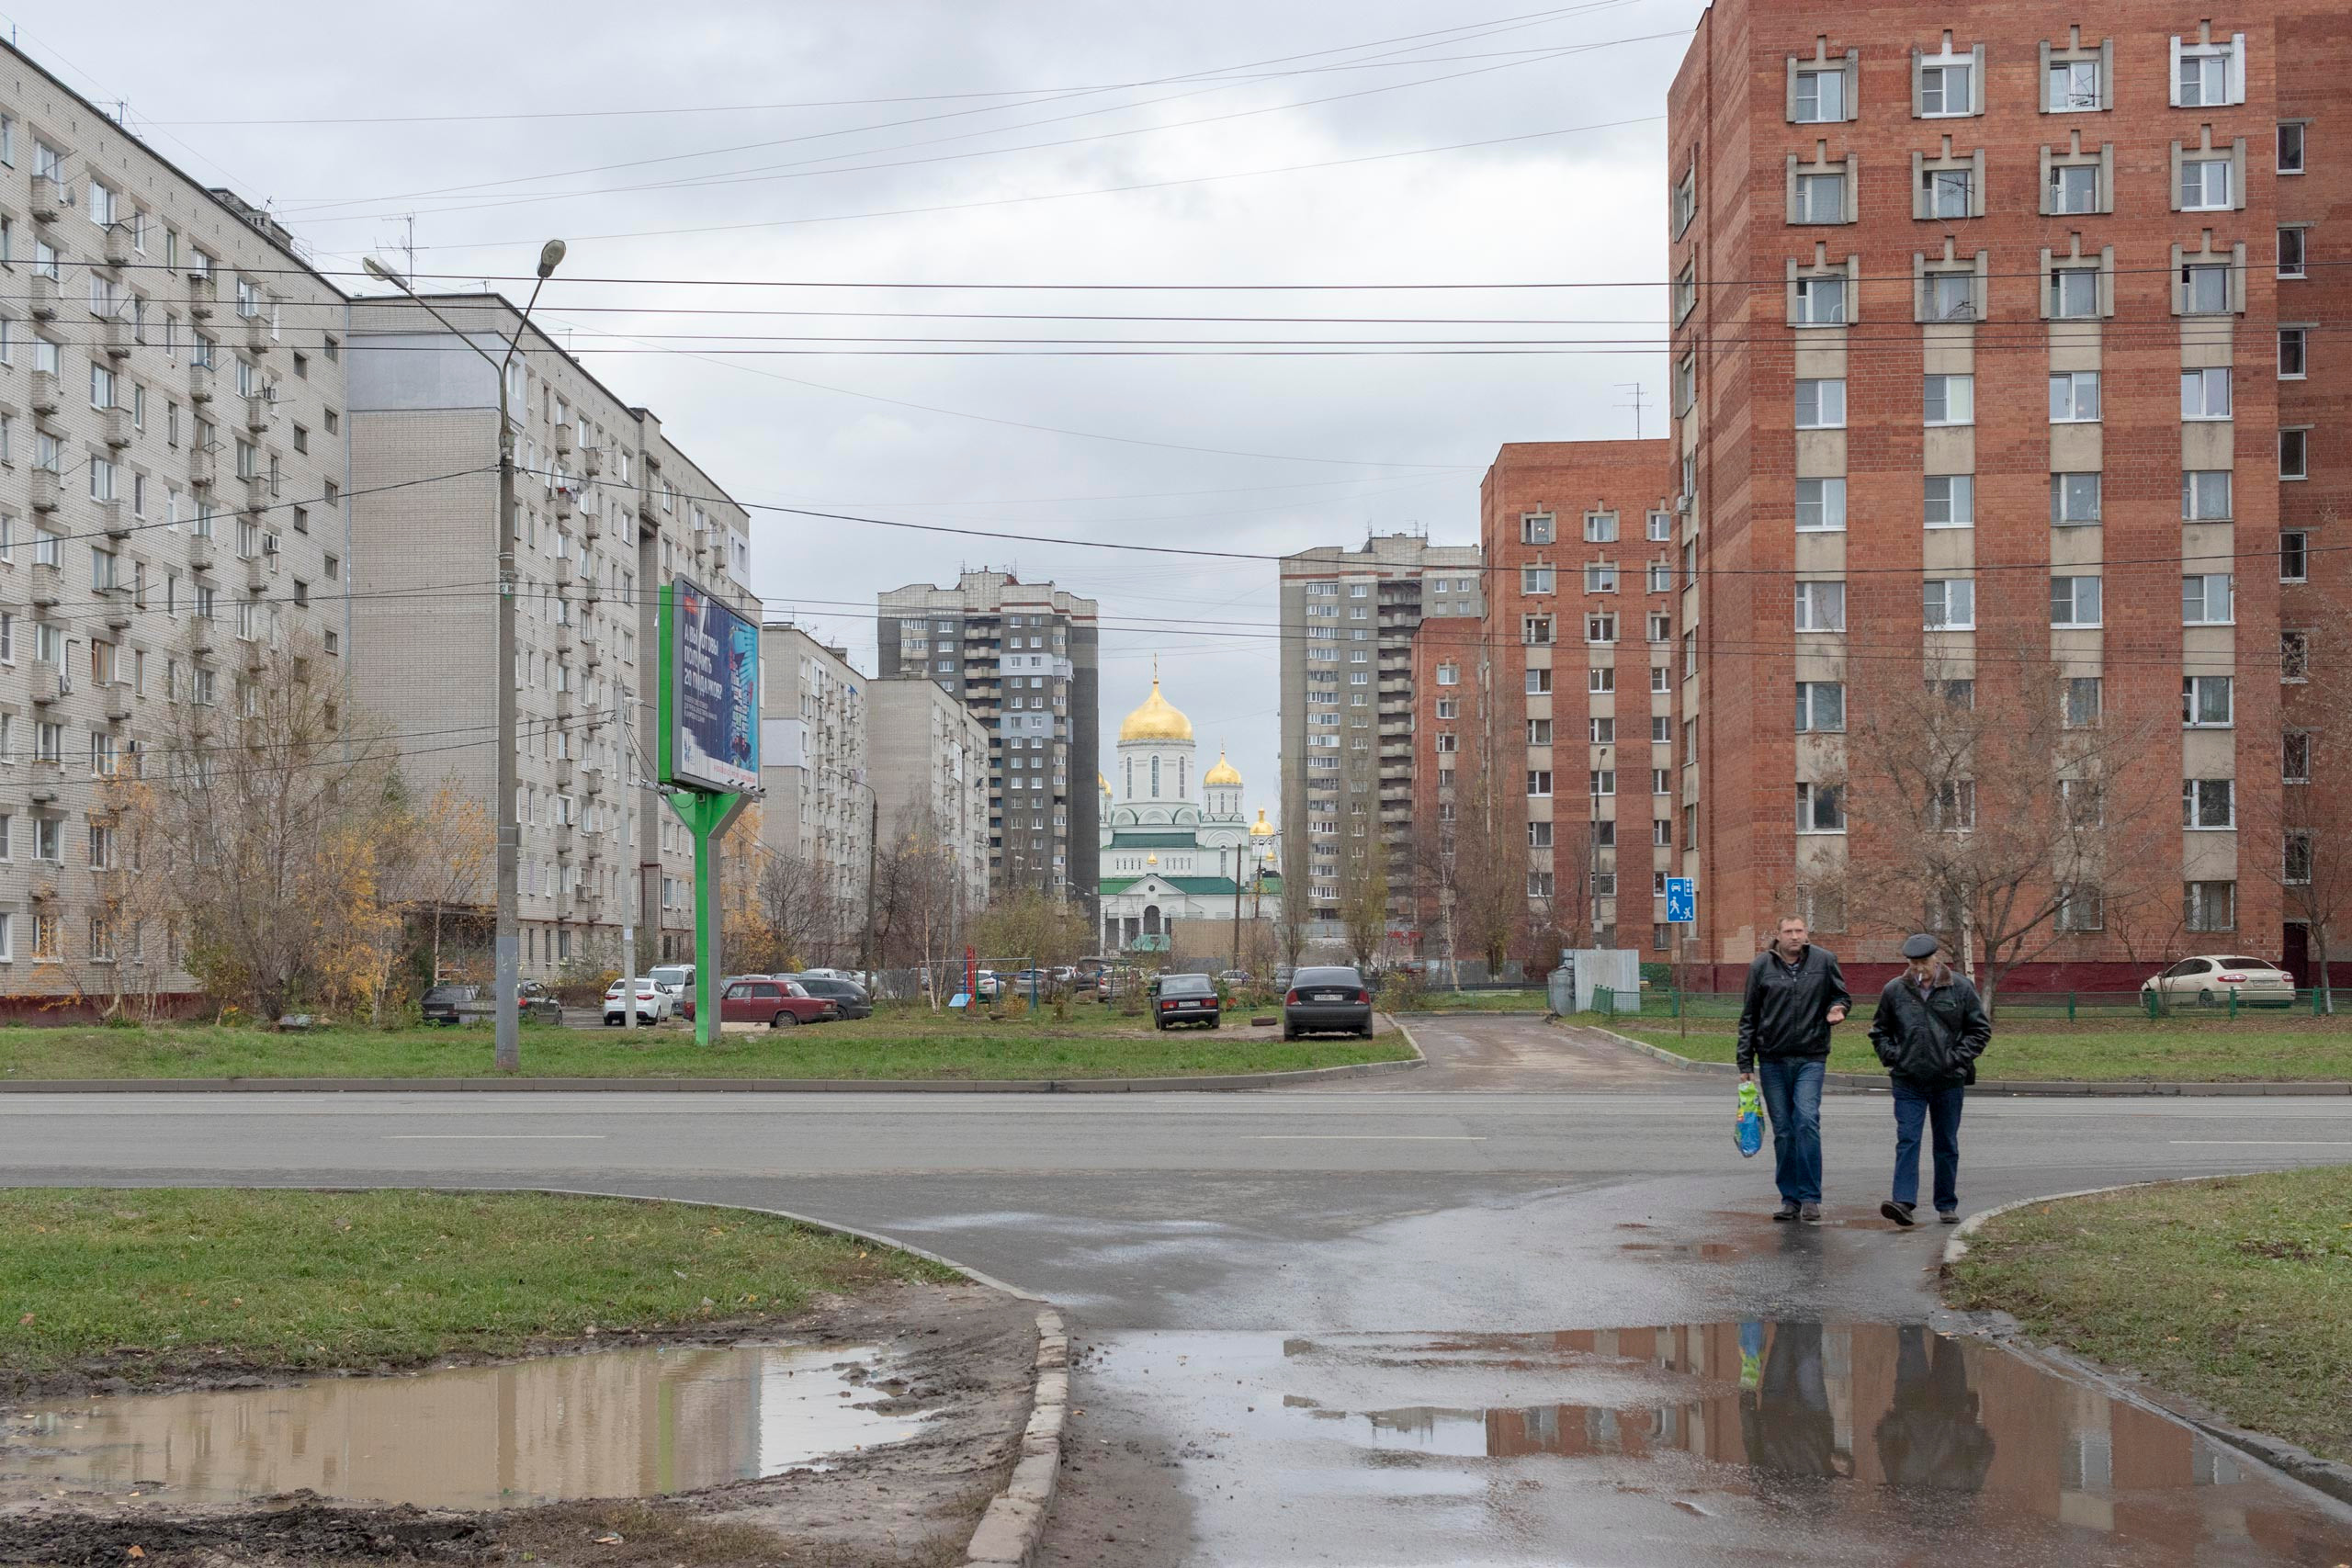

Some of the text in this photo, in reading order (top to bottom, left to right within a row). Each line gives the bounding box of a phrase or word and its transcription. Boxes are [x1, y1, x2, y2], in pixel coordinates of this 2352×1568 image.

[684, 623, 719, 657] А ВЫ ОТОВЫ
[684, 667, 692, 687] 20
